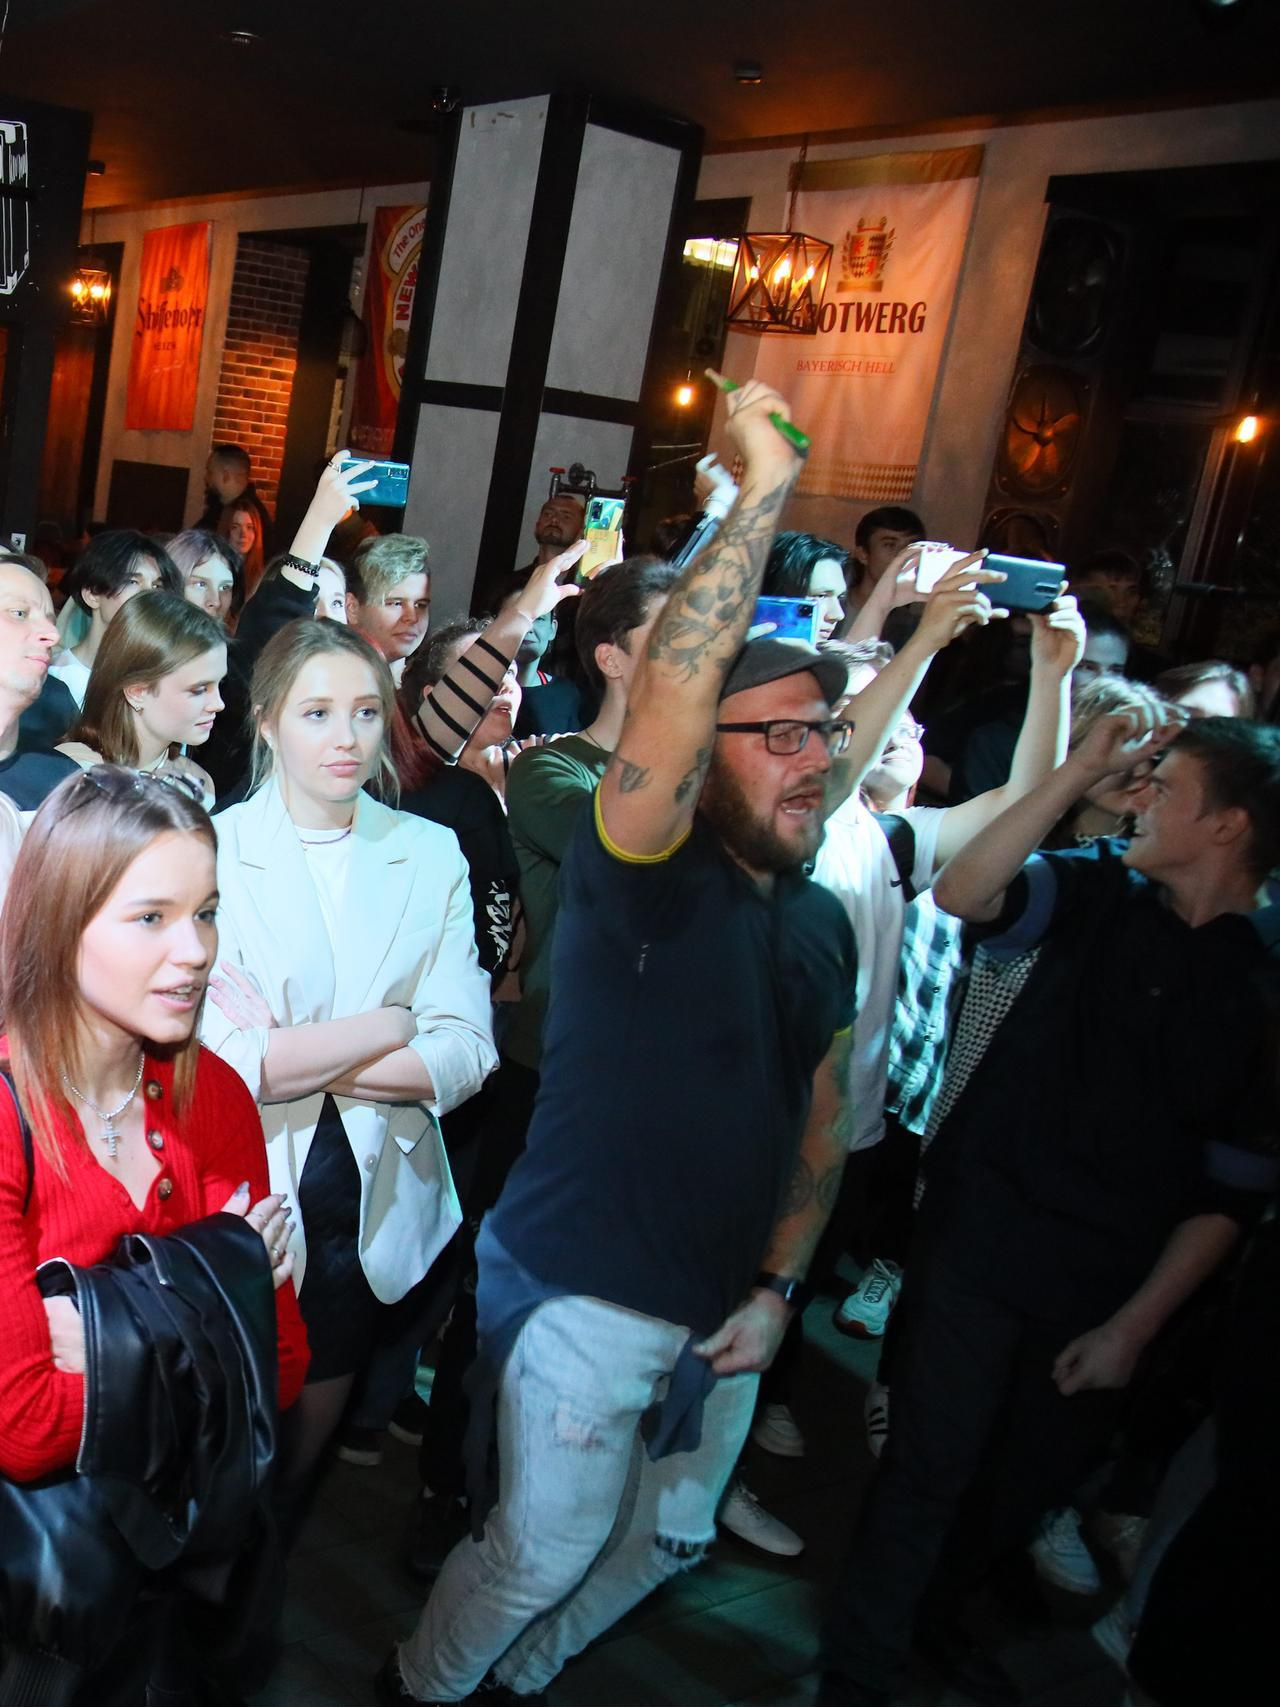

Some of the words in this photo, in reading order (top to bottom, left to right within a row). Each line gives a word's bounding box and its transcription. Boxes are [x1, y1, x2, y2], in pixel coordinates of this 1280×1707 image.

[394, 235, 410, 258] The
[793, 301, 927, 335] OTWERG
[796, 359, 863, 373] BAYERISCH
[865, 360, 896, 374] HELL
